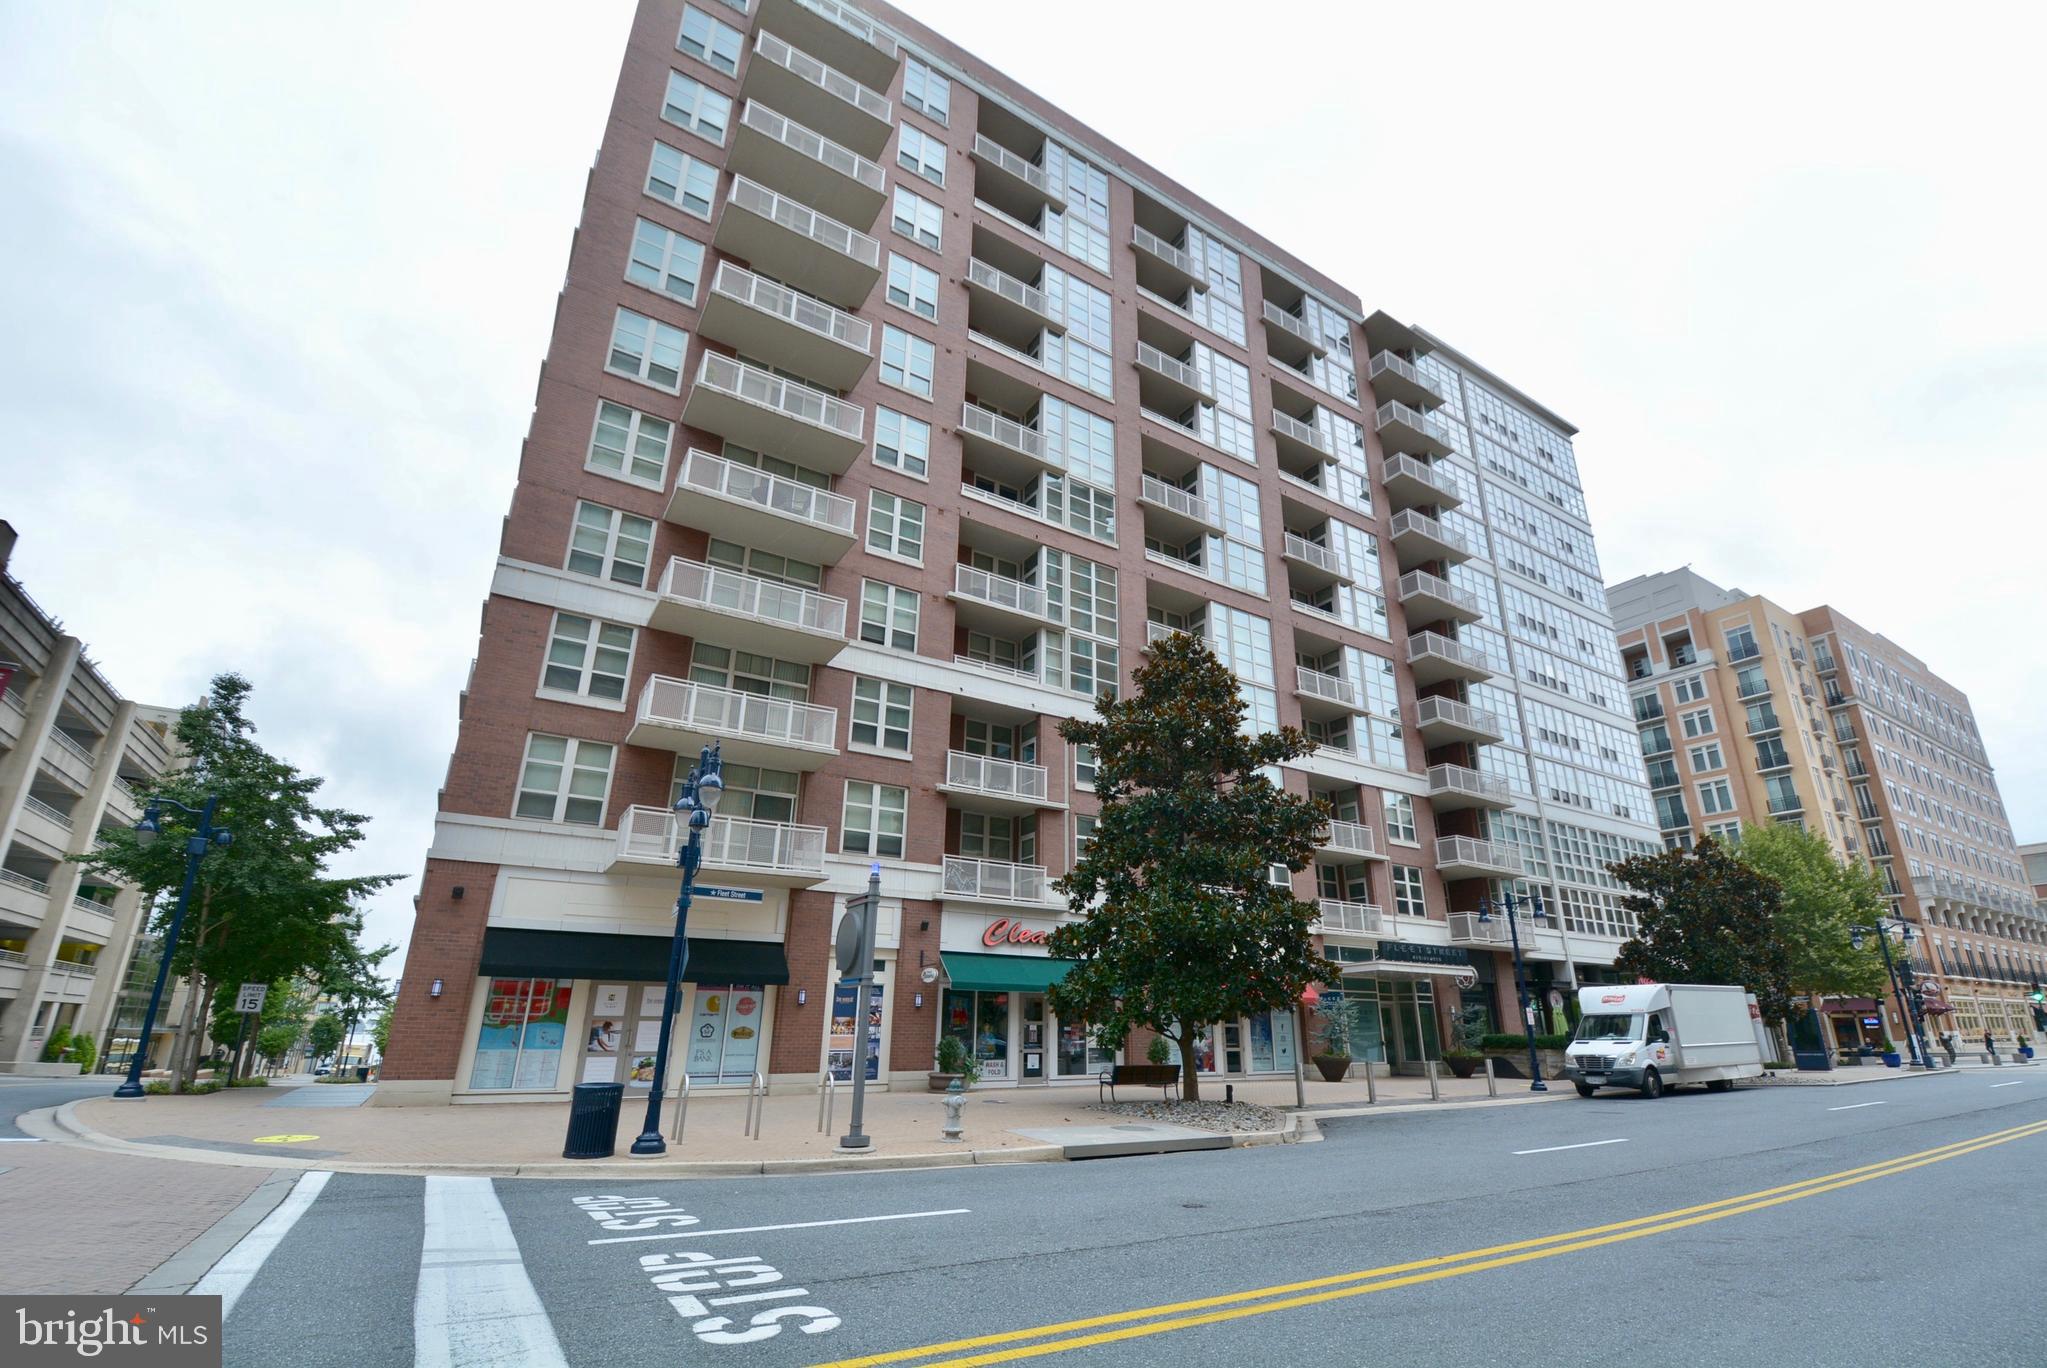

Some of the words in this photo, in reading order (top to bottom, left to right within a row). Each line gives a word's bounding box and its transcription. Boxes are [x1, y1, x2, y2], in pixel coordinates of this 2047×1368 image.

[716, 889, 730, 898] Fleet
[730, 890, 747, 899] Street
[982, 918, 1047, 947] Clea
[1386, 943, 1422, 954] FLEET
[1426, 946, 1463, 957] STREET
[241, 998, 259, 1010] 15
[986, 1061, 1000, 1069] WASH
[638, 1252, 842, 1345] STOP
